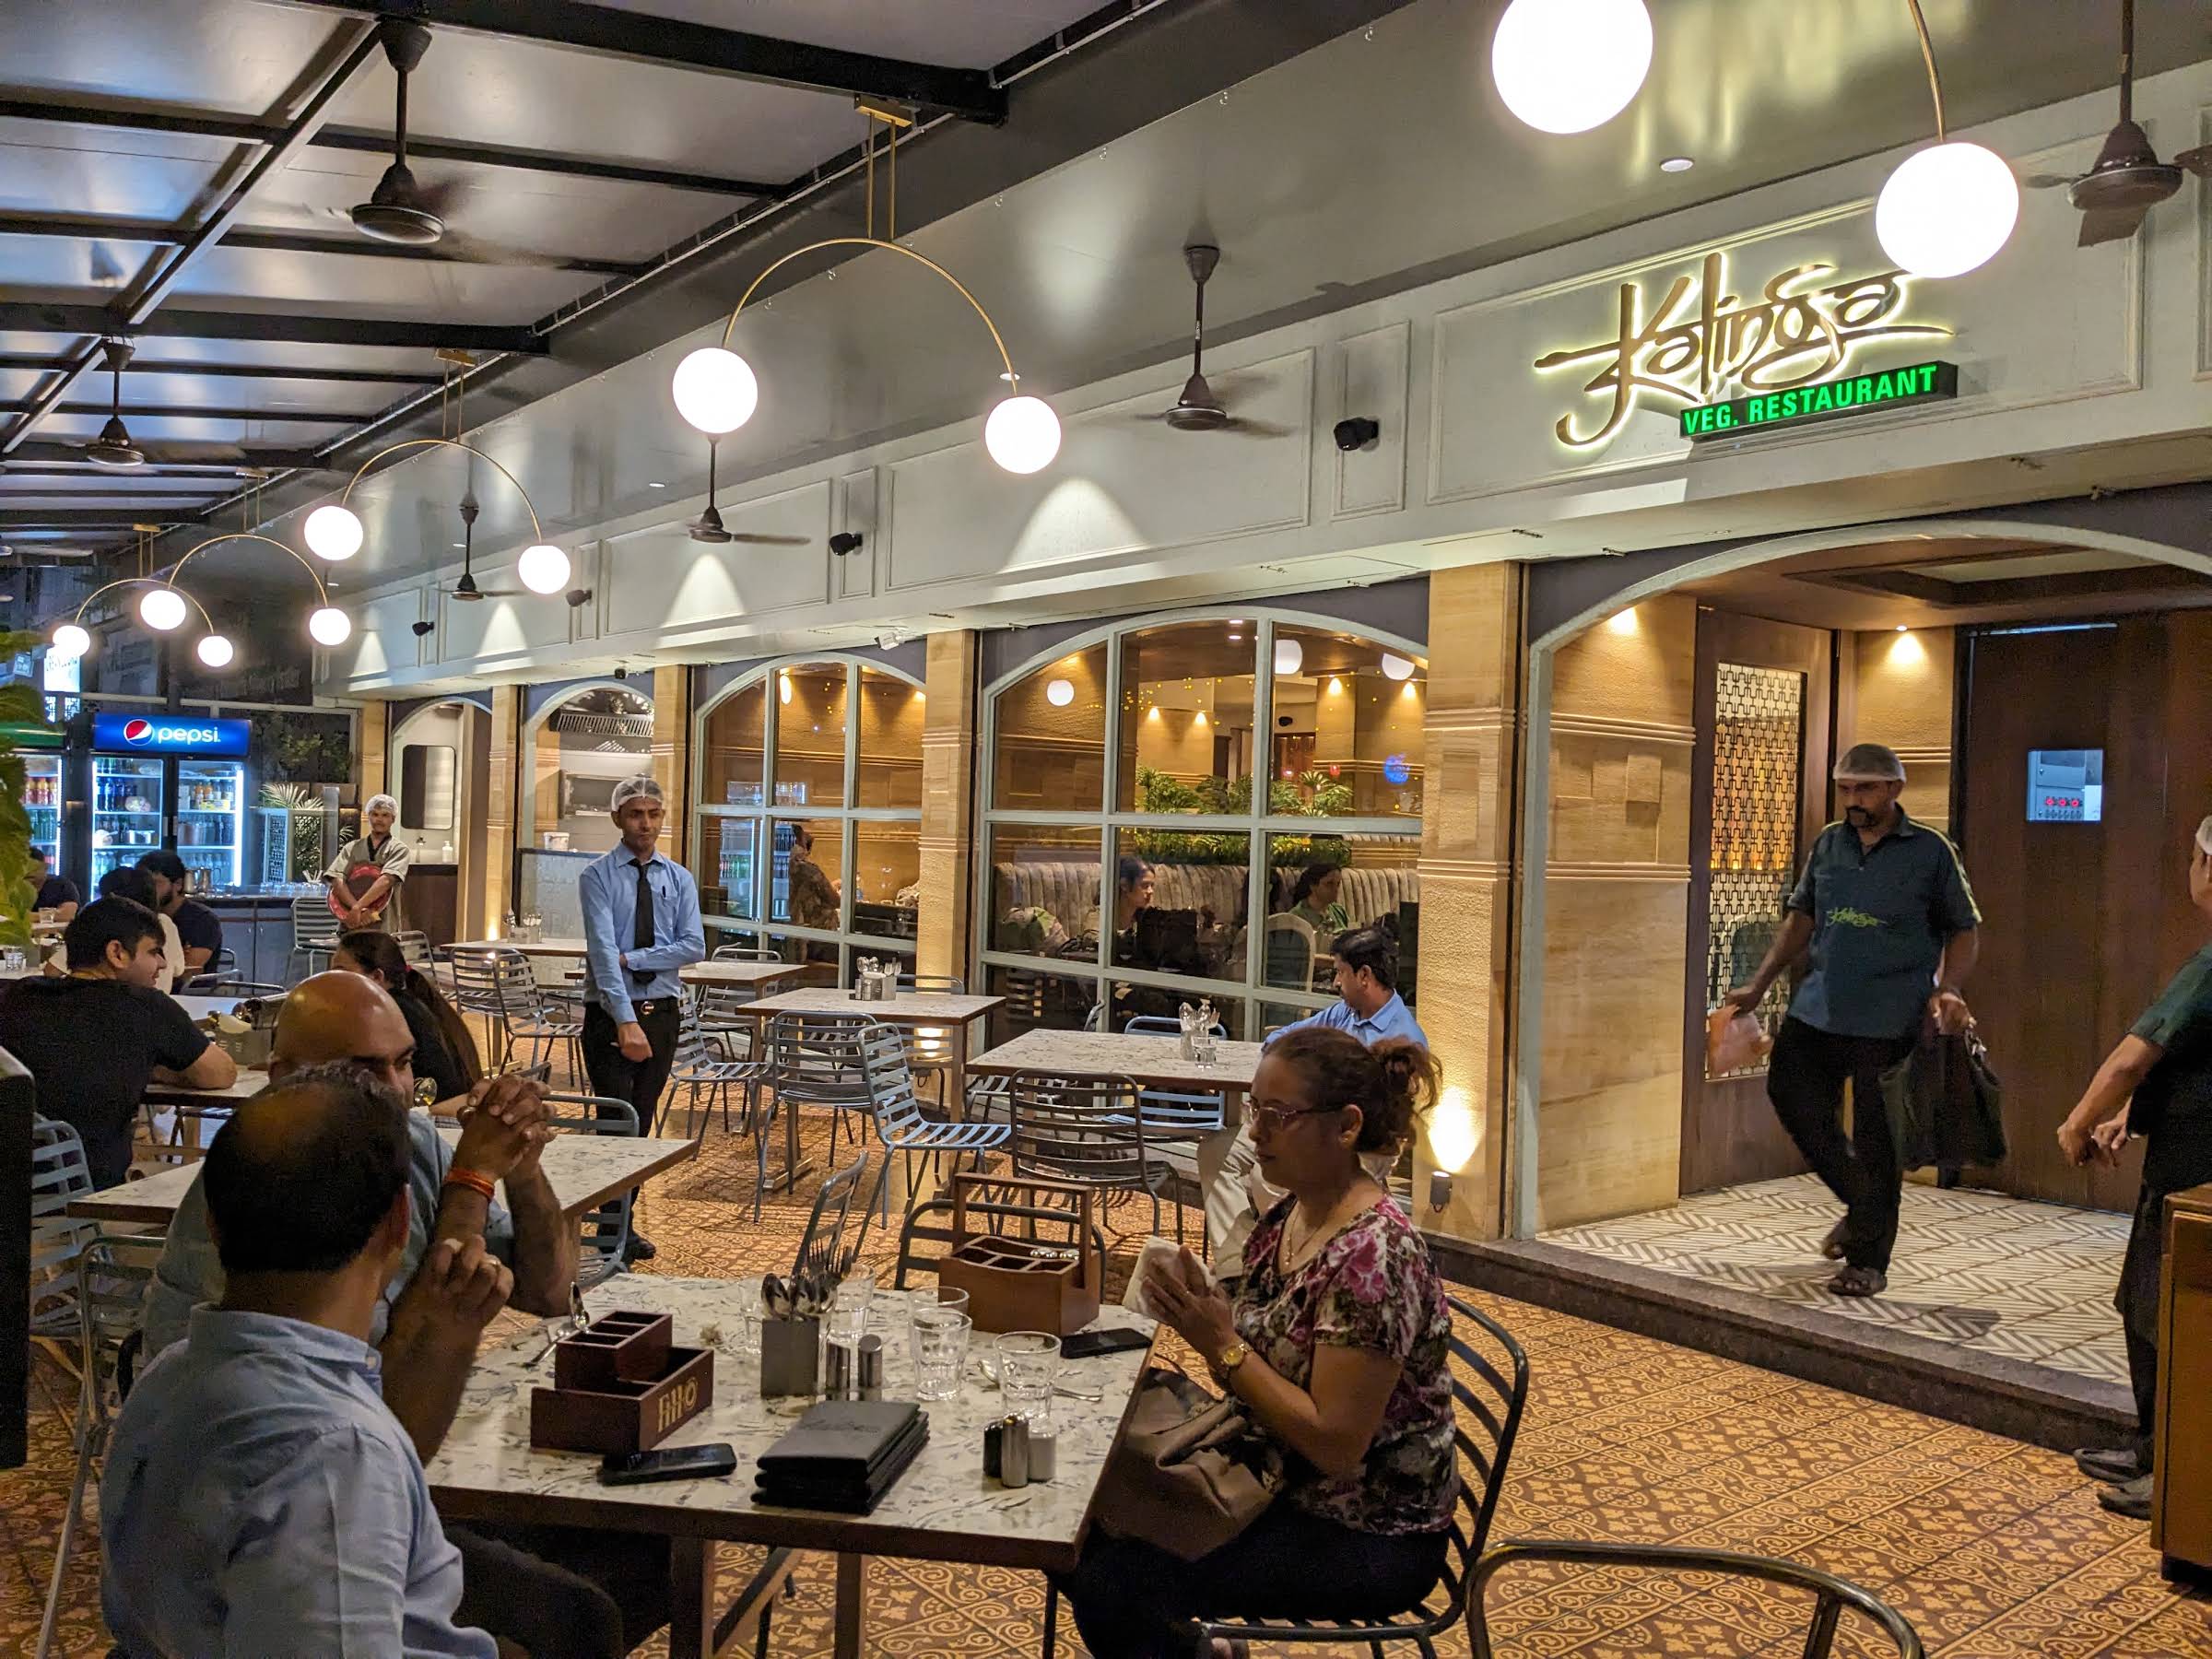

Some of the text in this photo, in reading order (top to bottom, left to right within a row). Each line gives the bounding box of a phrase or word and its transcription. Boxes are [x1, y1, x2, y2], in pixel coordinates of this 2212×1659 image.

[1534, 253, 1954, 446] Kalinga
[1684, 365, 1937, 435] VEG. RESTAURANT
[158, 726, 219, 745] pepsi
